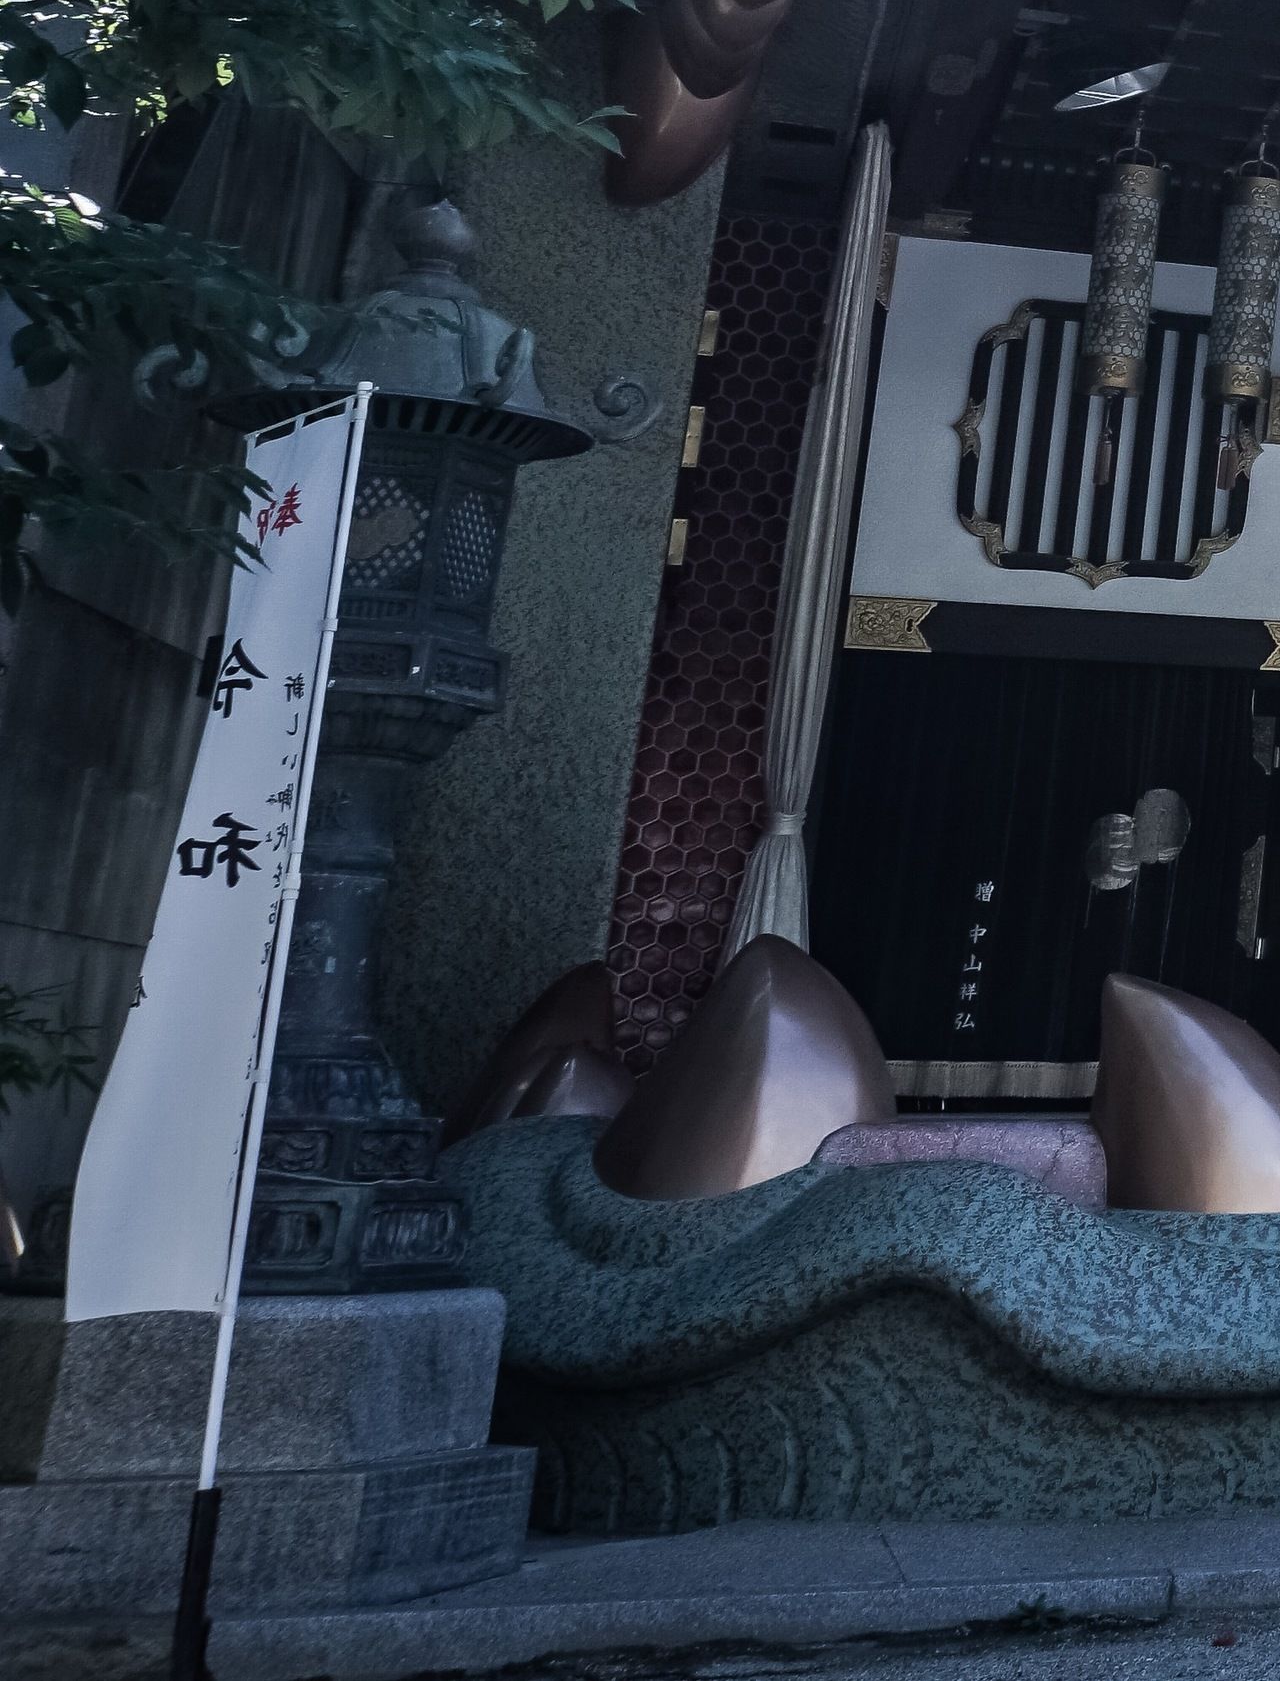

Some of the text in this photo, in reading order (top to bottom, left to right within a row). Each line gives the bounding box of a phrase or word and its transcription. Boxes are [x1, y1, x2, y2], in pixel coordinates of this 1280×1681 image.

[954, 881, 995, 1030] 贈 中山祥弘
